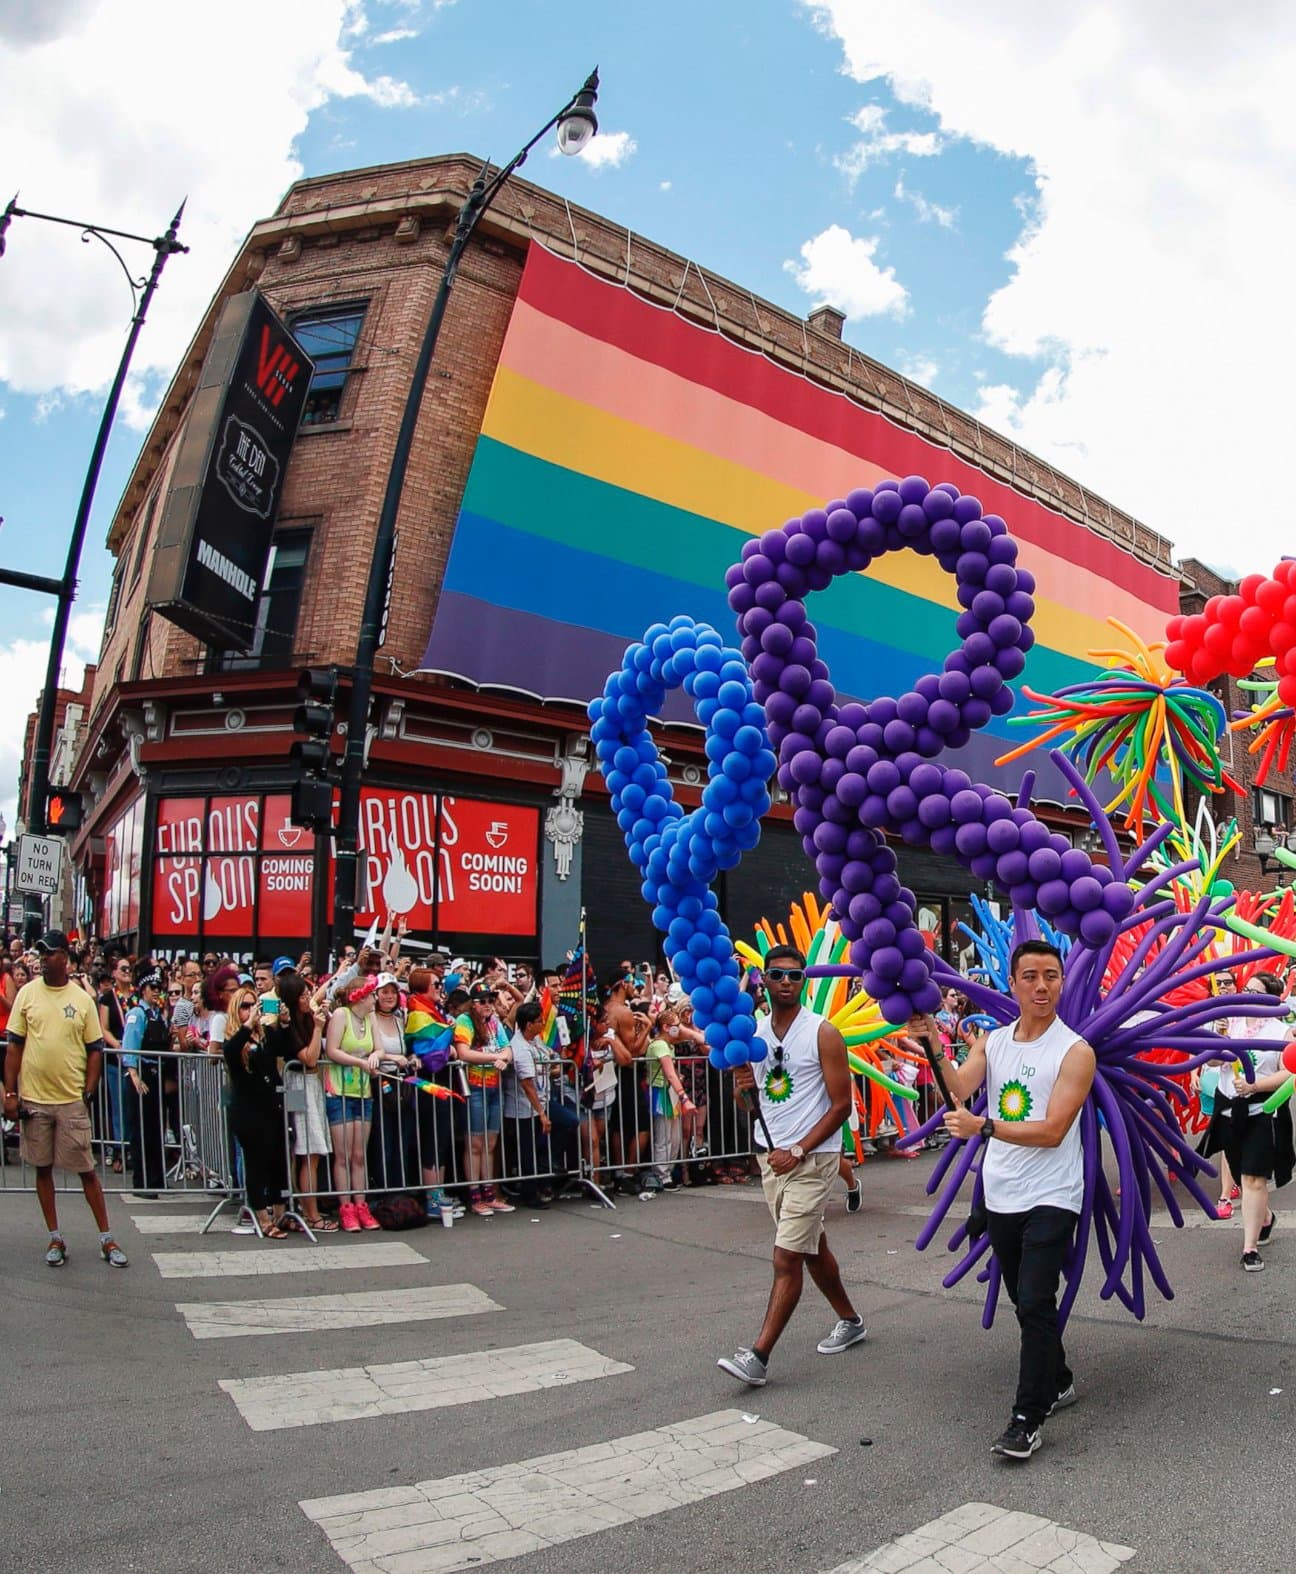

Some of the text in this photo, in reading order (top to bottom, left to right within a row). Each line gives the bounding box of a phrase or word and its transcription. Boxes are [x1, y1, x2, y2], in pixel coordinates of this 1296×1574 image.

[236, 431, 251, 462] THE
[197, 538, 257, 602] MANHOLE
[157, 800, 258, 874] FUROUS
[33, 843, 48, 855] NO
[28, 857, 52, 871] TURN
[261, 859, 314, 875] COMING
[461, 853, 528, 875] COMING
[20, 872, 56, 888] ON RED
[266, 875, 309, 891] SOON!
[469, 873, 522, 894] SOON!
[1020, 1063, 1036, 1079] bp
